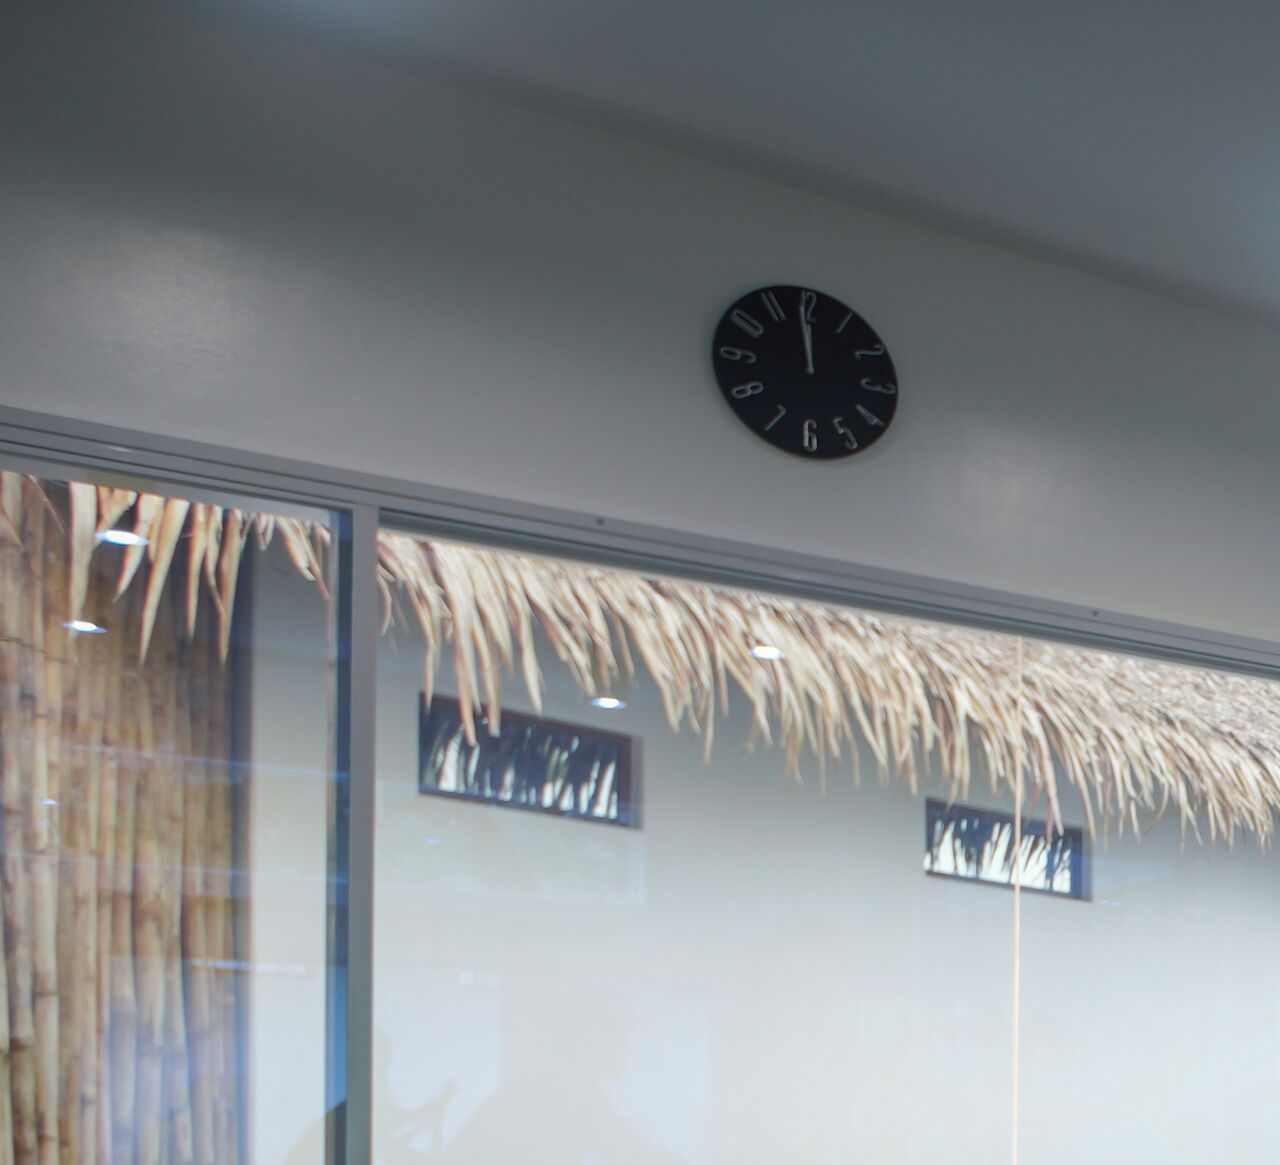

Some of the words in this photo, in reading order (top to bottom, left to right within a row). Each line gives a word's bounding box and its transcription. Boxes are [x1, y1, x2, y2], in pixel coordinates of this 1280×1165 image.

[720, 345, 757, 364] 9
[854, 344, 885, 360] 2
[731, 380, 764, 399] 8
[860, 377, 896, 395] 3
[765, 404, 787, 431] 7
[802, 418, 818, 452] 6
[832, 416, 858, 450] 5
